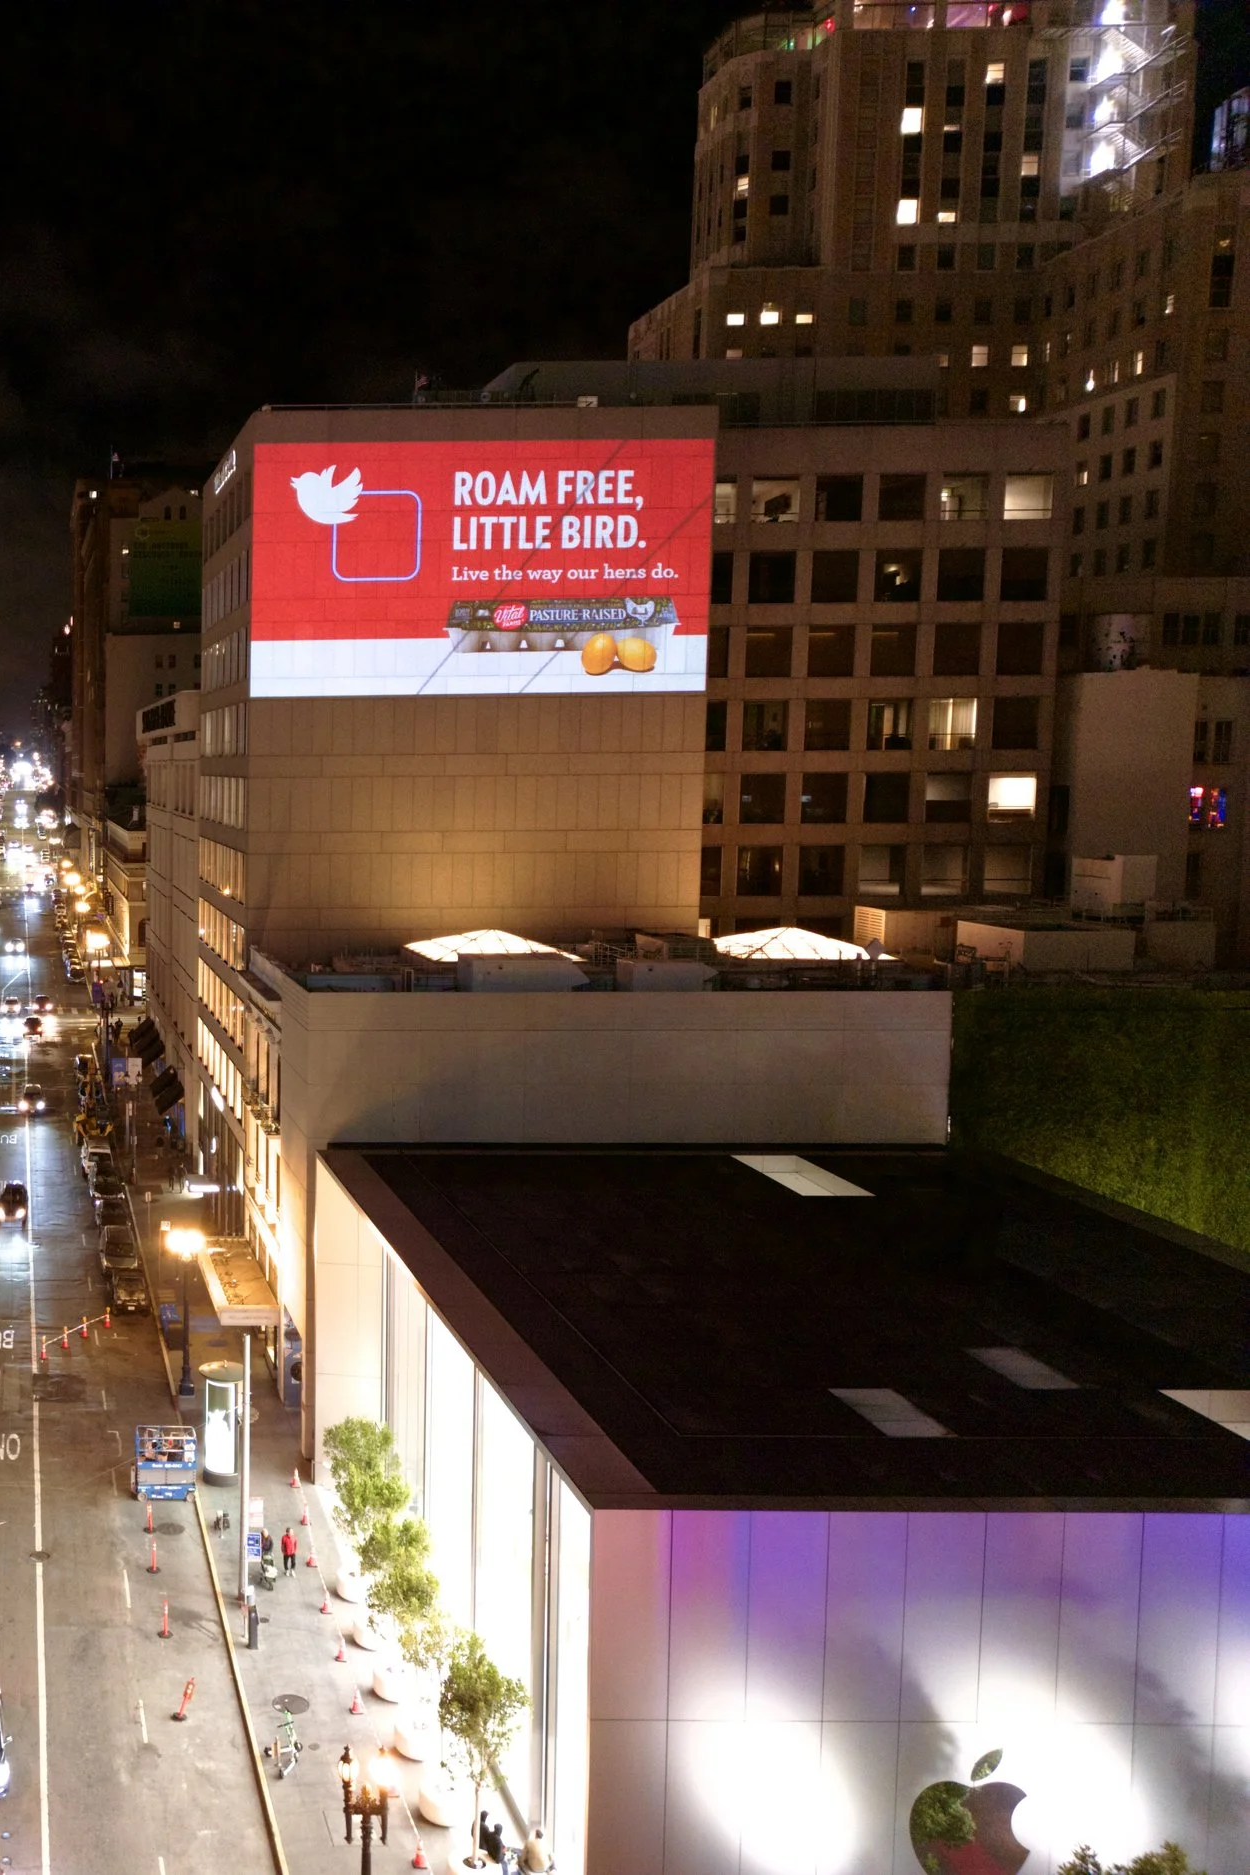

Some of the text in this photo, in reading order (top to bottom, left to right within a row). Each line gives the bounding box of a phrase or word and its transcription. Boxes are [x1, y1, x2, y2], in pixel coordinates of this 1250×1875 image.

[453, 469, 645, 511] ROAM FREE,
[452, 514, 647, 551] LITTLE BIRD.
[451, 563, 680, 583] Live the way our hens do.
[493, 604, 526, 623] Vital
[530, 608, 627, 621] PASTURE-RAISED
